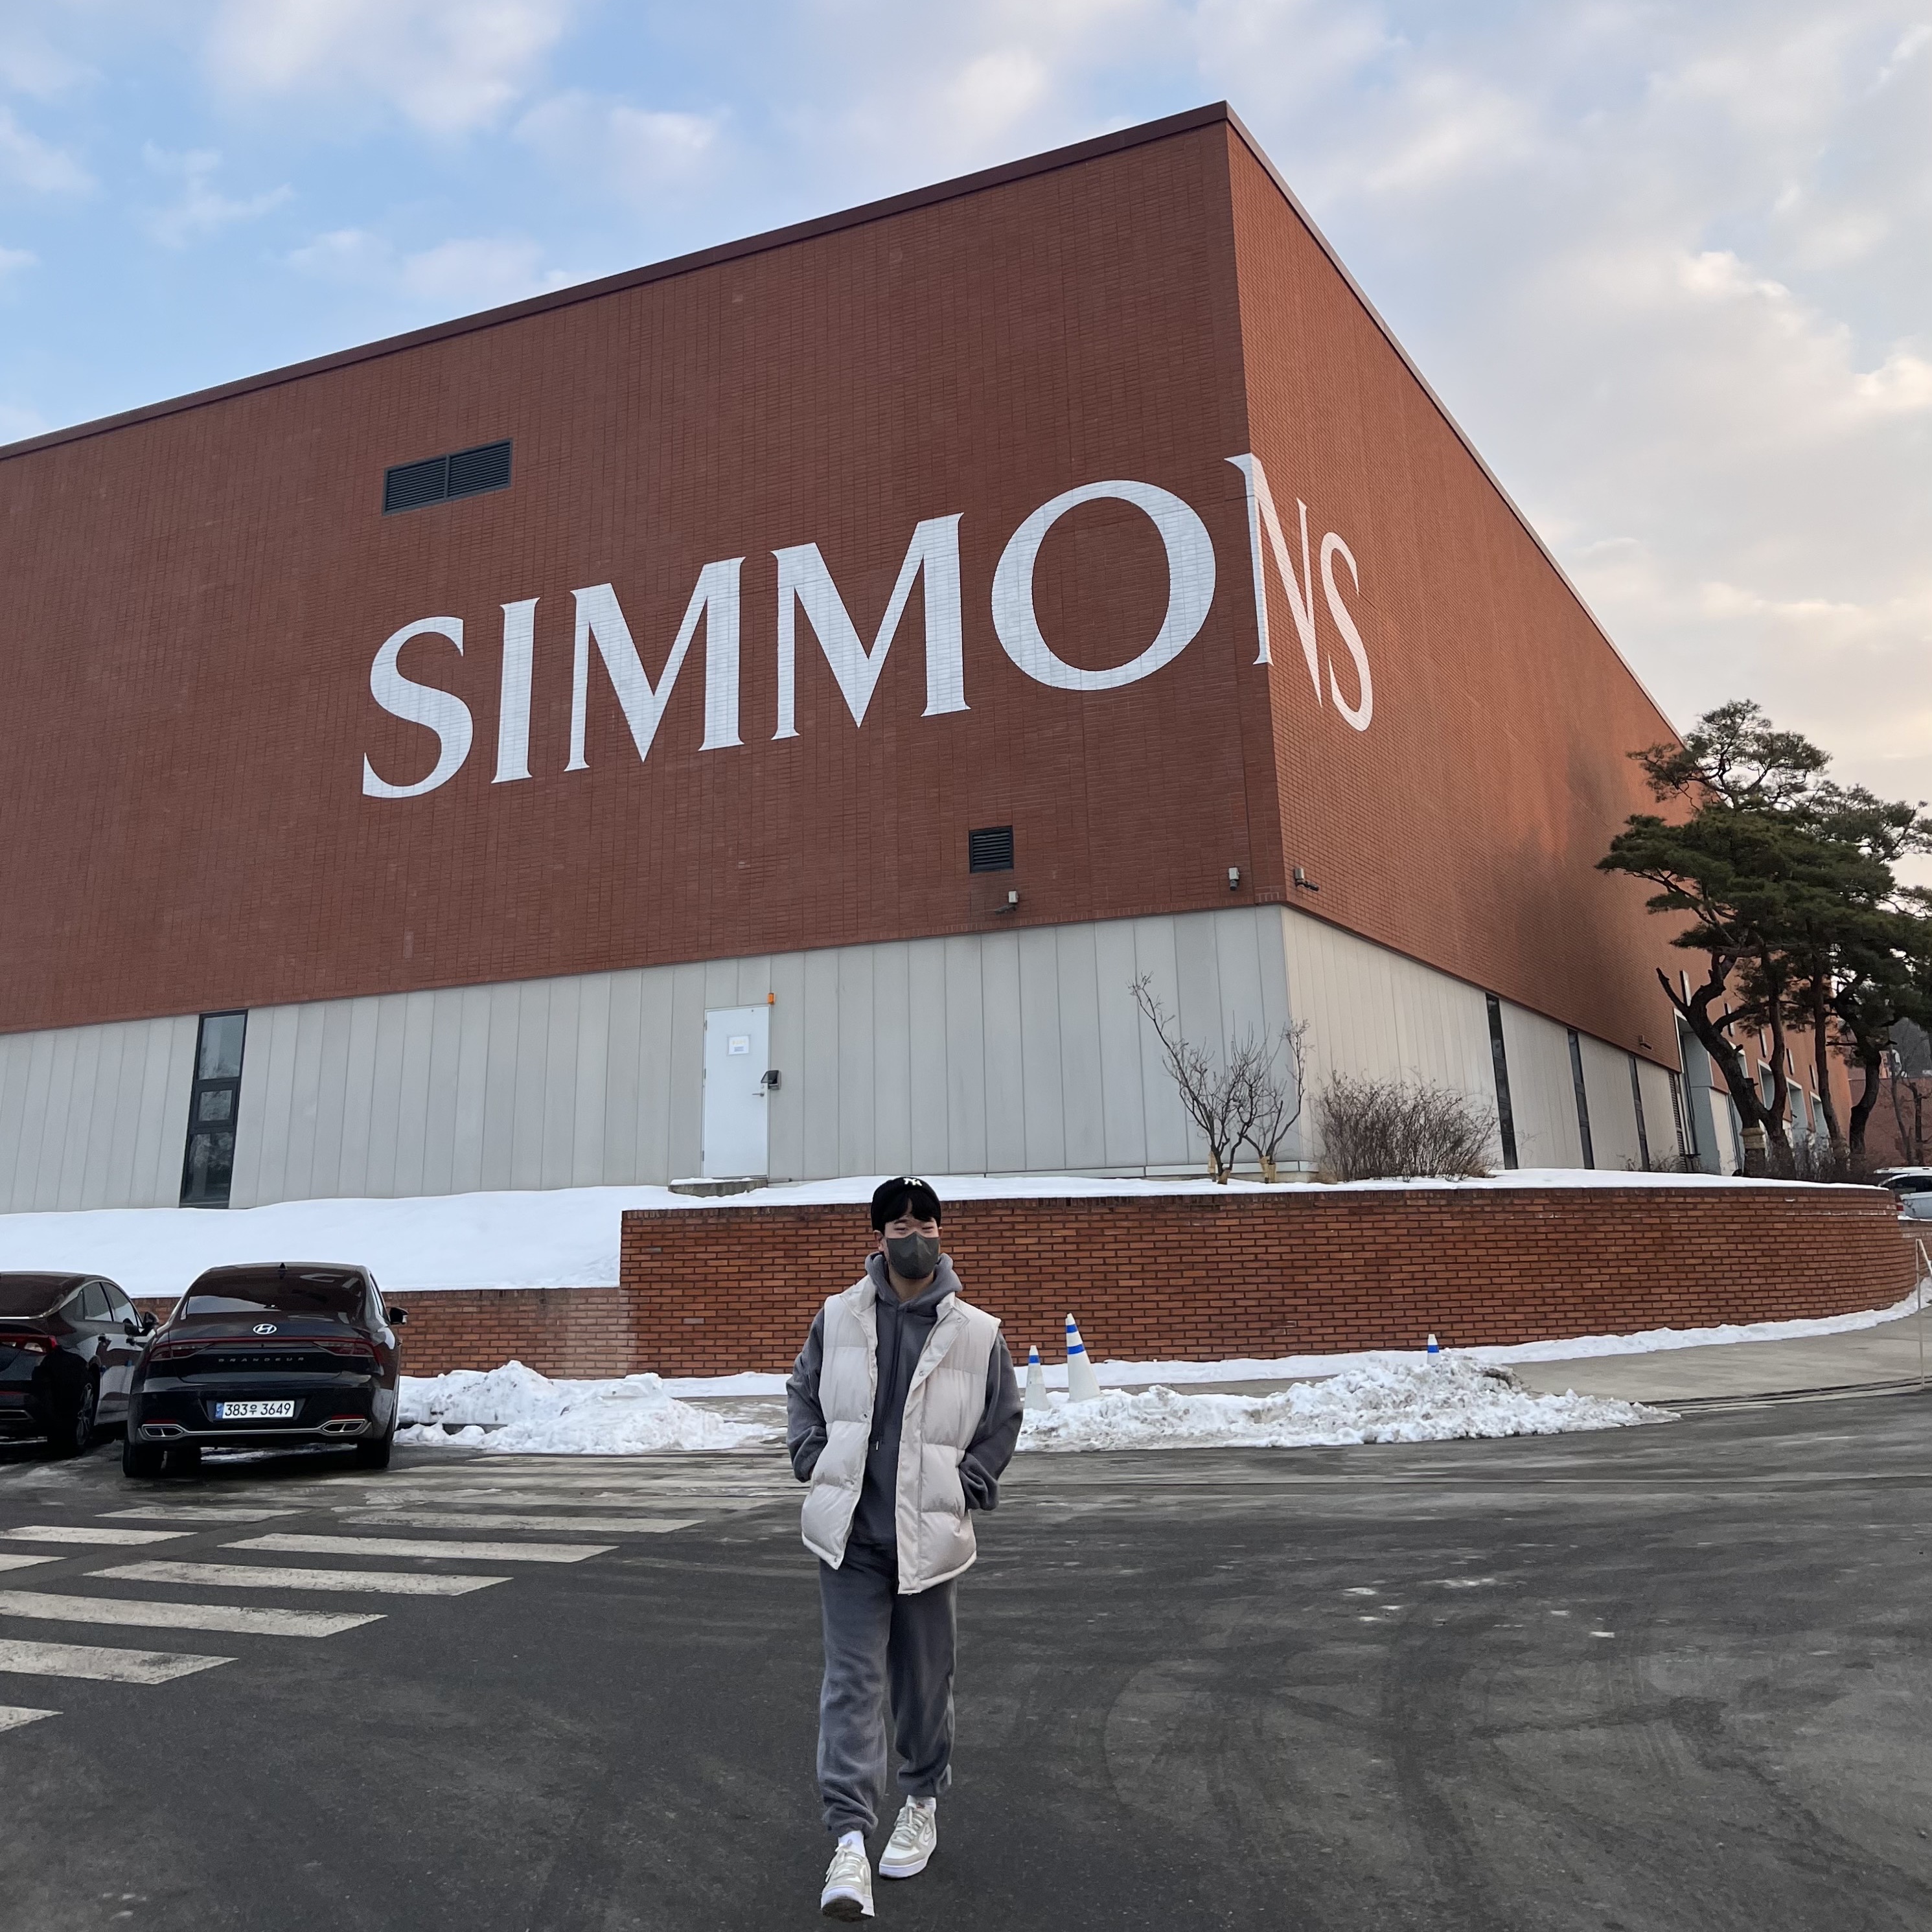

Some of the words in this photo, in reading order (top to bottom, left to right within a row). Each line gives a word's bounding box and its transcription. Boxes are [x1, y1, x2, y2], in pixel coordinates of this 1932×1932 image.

[362, 452, 1373, 798] SIMMONS
[225, 1403, 257, 1416] 383우
[260, 1403, 291, 1416] 3649
